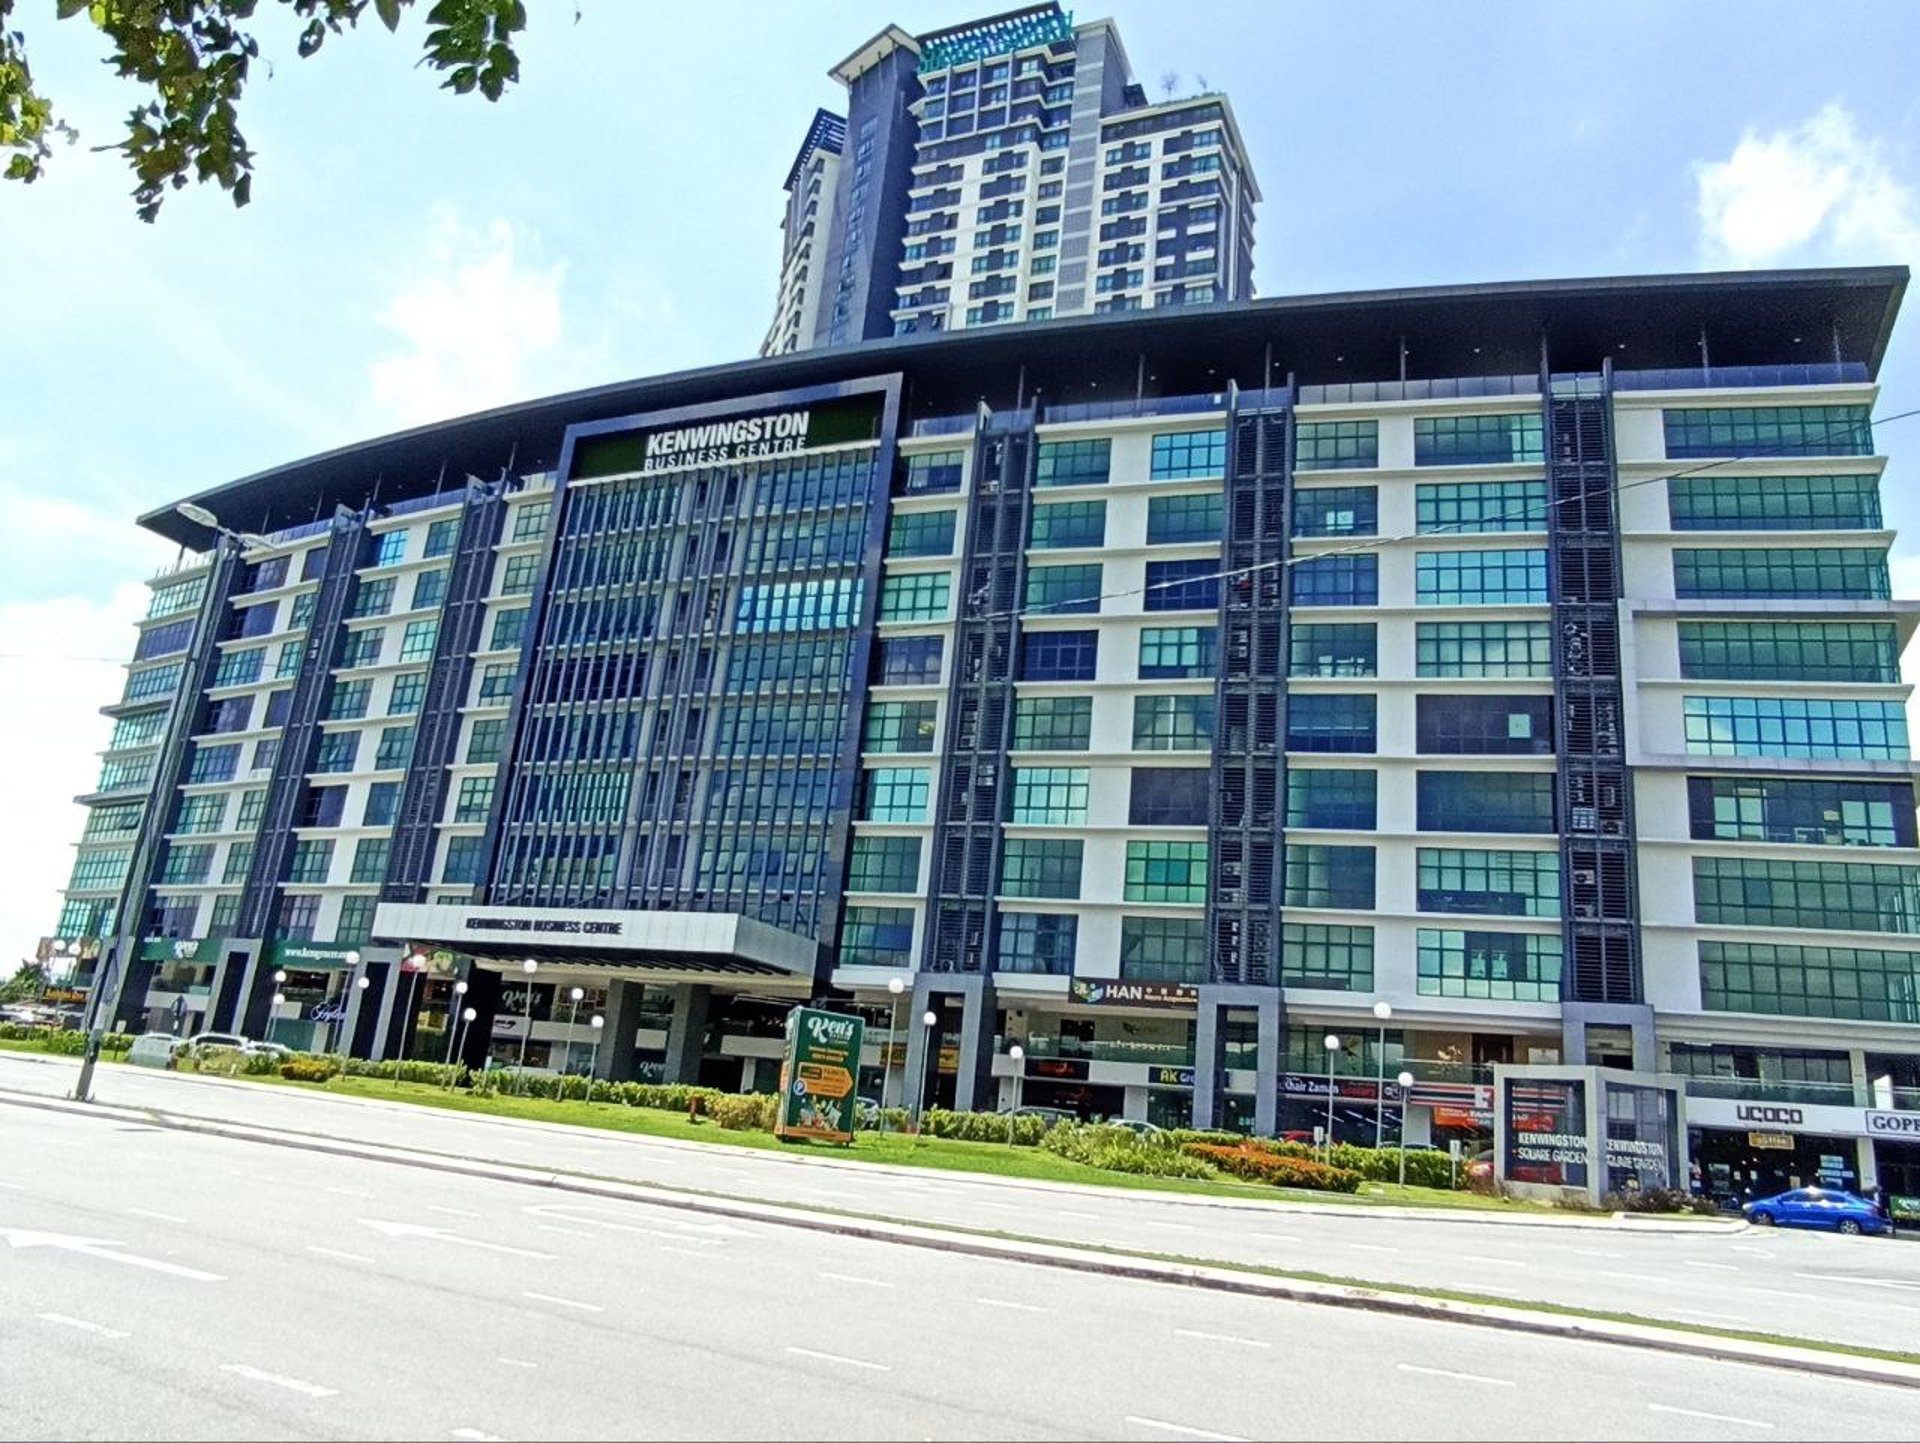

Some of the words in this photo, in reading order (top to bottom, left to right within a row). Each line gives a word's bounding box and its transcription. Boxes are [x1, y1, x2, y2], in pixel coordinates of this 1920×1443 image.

[647, 411, 809, 457] KENWINGSTON
[644, 446, 729, 472] BUSINESS
[736, 436, 807, 459] CENTRE
[533, 920, 581, 933] BUSINESS
[583, 922, 622, 935] CENTRE
[1105, 984, 1142, 999] HAN
[807, 1017, 854, 1043] Ken's
[1160, 1068, 1178, 1082] AK
[1518, 1132, 1588, 1148] KENWINGSTON
[1518, 1148, 1551, 1161] SQUARE
[1553, 1150, 1589, 1164] GARDEN
